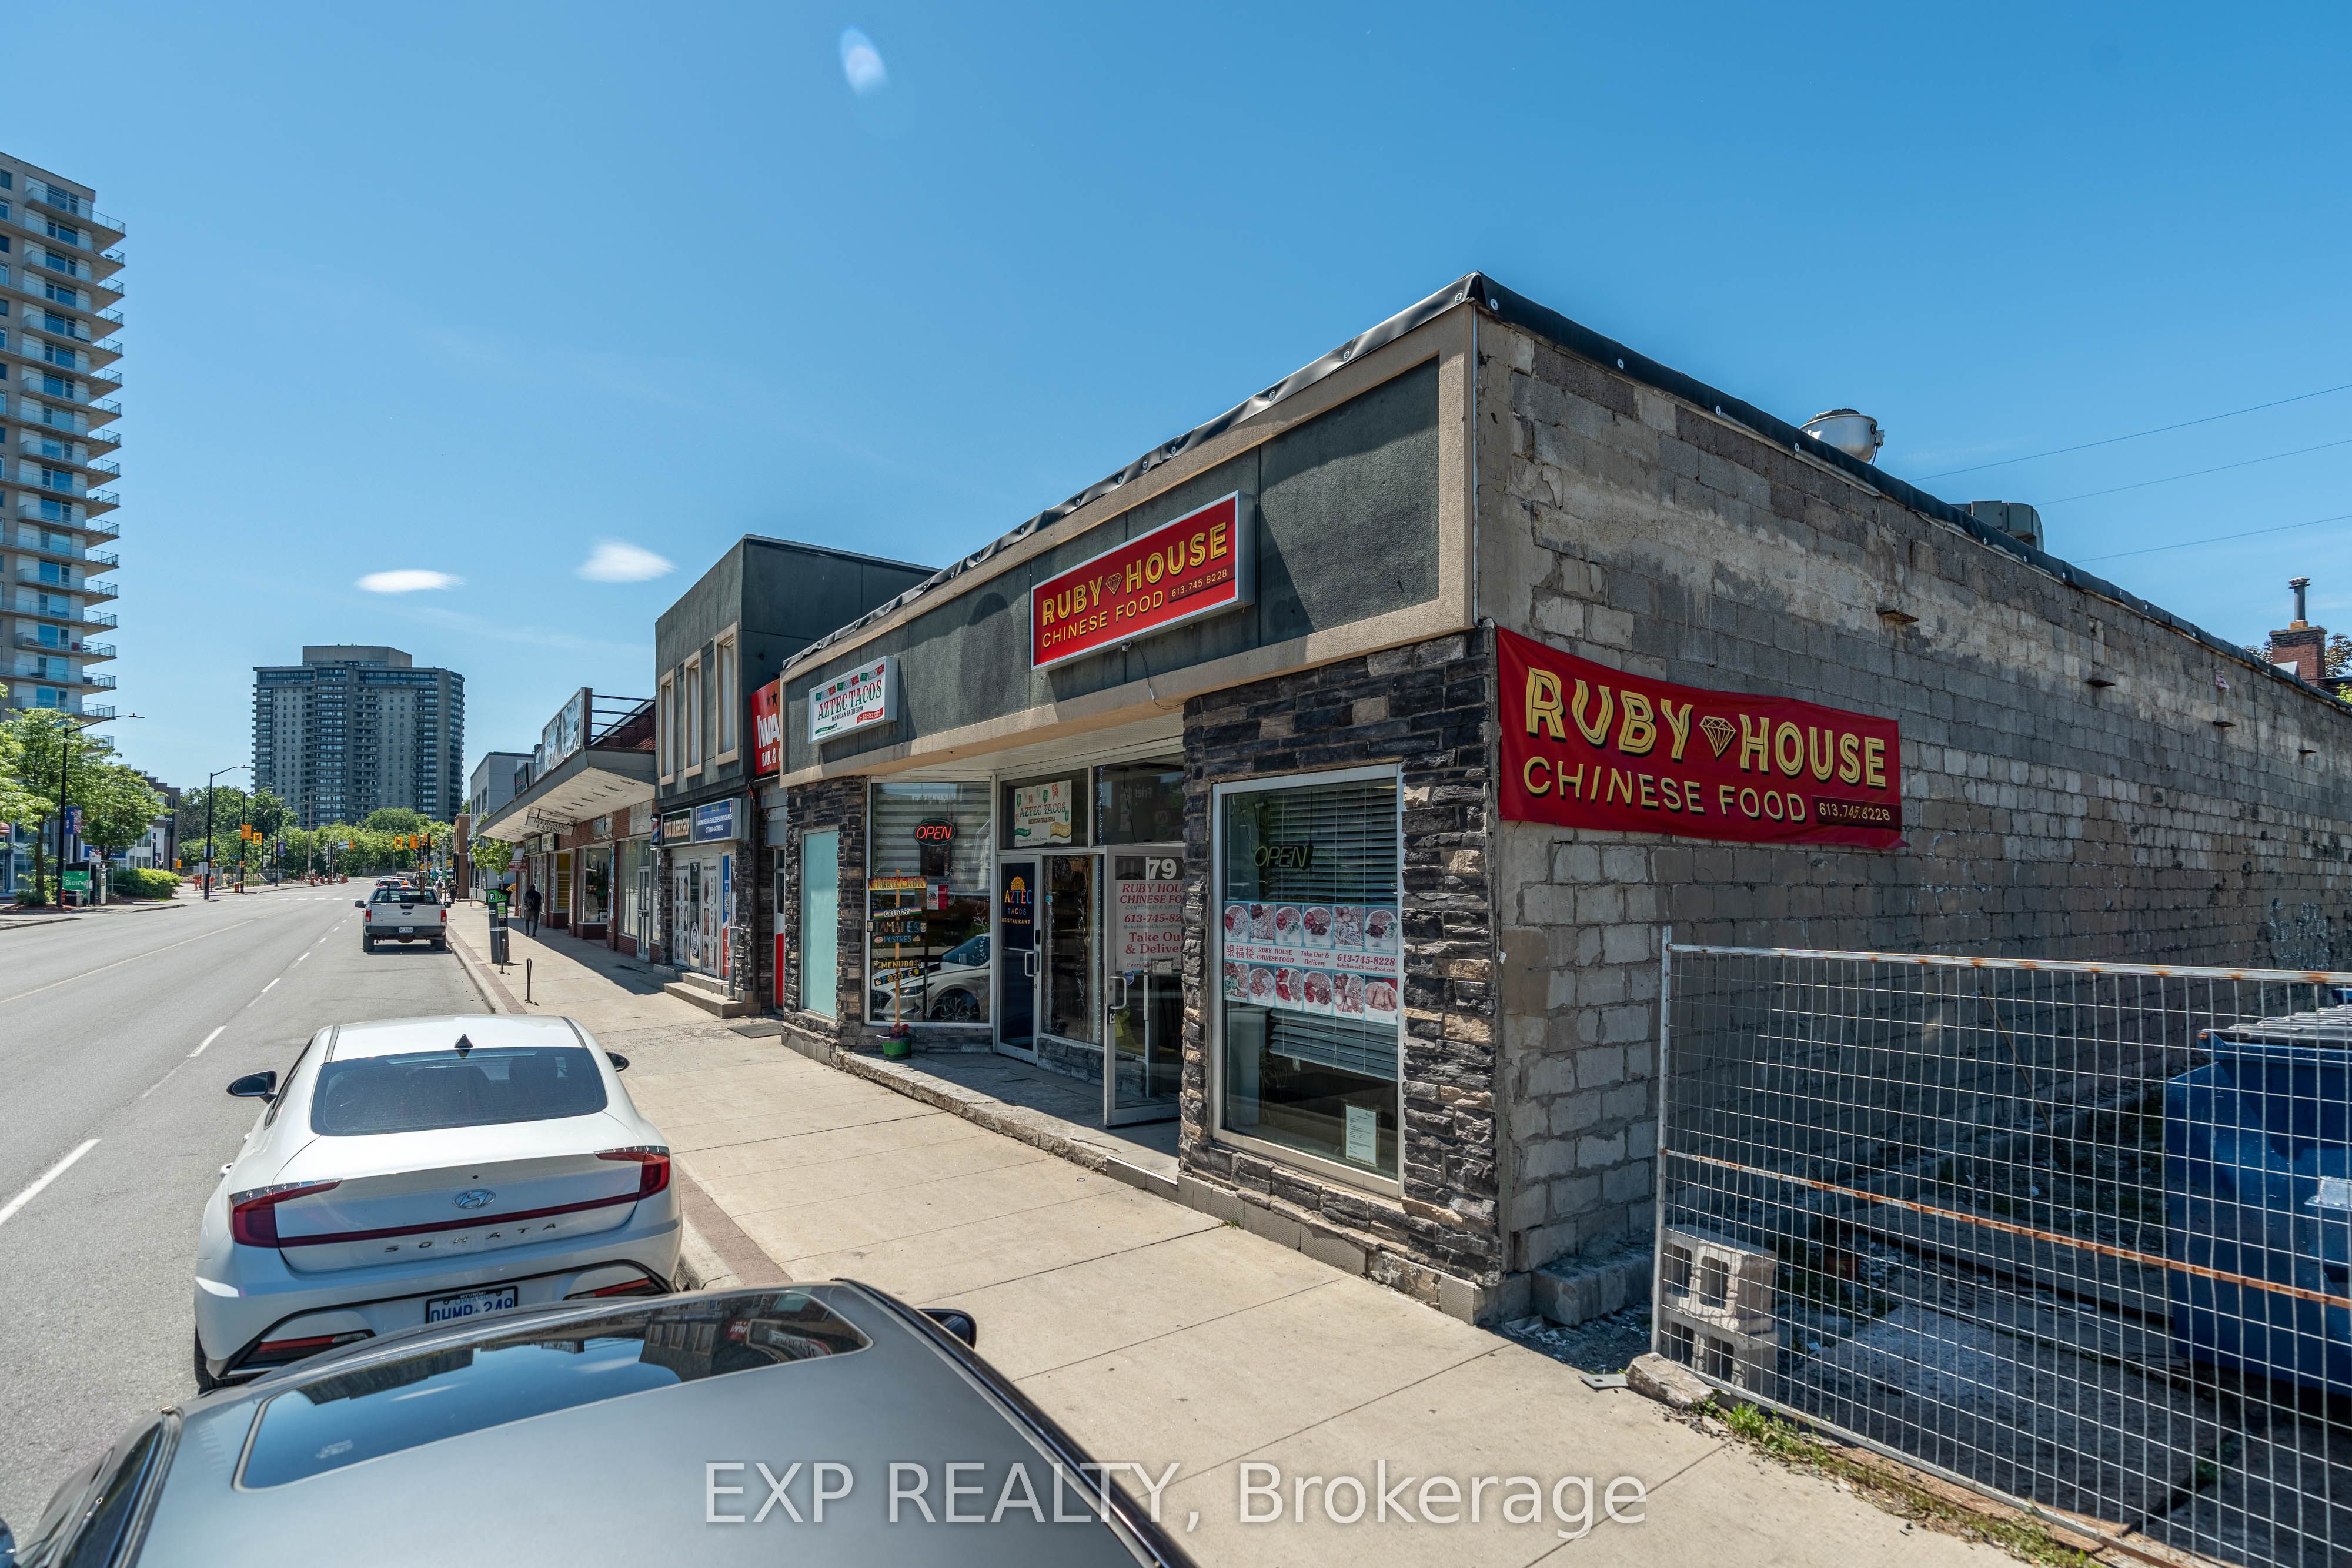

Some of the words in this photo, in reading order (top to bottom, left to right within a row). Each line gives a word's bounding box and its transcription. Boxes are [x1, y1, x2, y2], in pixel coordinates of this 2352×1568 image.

[1043, 576, 1102, 626] RUBY
[1126, 522, 1228, 594] HOUSE
[1171, 569, 1228, 597] 613.745.8228
[1043, 611, 1108, 648] CHINESE
[1116, 591, 1164, 622] FOOD
[818, 693, 847, 720] AZTEC
[850, 679, 881, 708] TACOS
[832, 711, 846, 722] MEXICAN
[846, 706, 864, 717] TAQUERIA
[757, 713, 780, 749] IWA
[1526, 666, 1694, 762] RUBY
[1739, 714, 1886, 788] HOUSE
[762, 750, 771, 767] BAR
[772, 748, 776, 764] &
[1524, 756, 1705, 813] CHINESE
[1719, 784, 1806, 823] FOOD
[1020, 805, 1041, 818] AZTEC
[1044, 801, 1066, 815] TACOS
[1819, 802, 1890, 821] 613.745.8228
[534, 818, 569, 830] MERCADO
[537, 824, 563, 833] LATINO
[916, 826, 952, 840] OPEN
[1254, 845, 1307, 867] OPEN
[1147, 858, 1176, 880] 79
[1122, 884, 1154, 893] RUBY
[1157, 884, 1183, 893] HOU
[1004, 889, 1032, 904] AZTEC
[1120, 895, 1166, 904] CHINESE
[1168, 895, 1182, 904] FO
[1124, 914, 1181, 923] 613-745-82
[874, 921, 920, 934] TAMALES
[1129, 932, 1159, 942] Take
[1162, 931, 1185, 941] Out
[1125, 944, 1135, 954] &
[1226, 944, 1255, 959] 银福楼
[881, 960, 914, 969] MENUDO
[1304, 959, 1326, 968] Delivery
[1337, 954, 1395, 966] 613-745-8228
[1336, 963, 1396, 973] RubyHouseChineseFood.com
[882, 969, 914, 984] POZOLE
[385, 1223, 556, 1252] SONATA
[455, 1295, 490, 1305] ONTARIO
